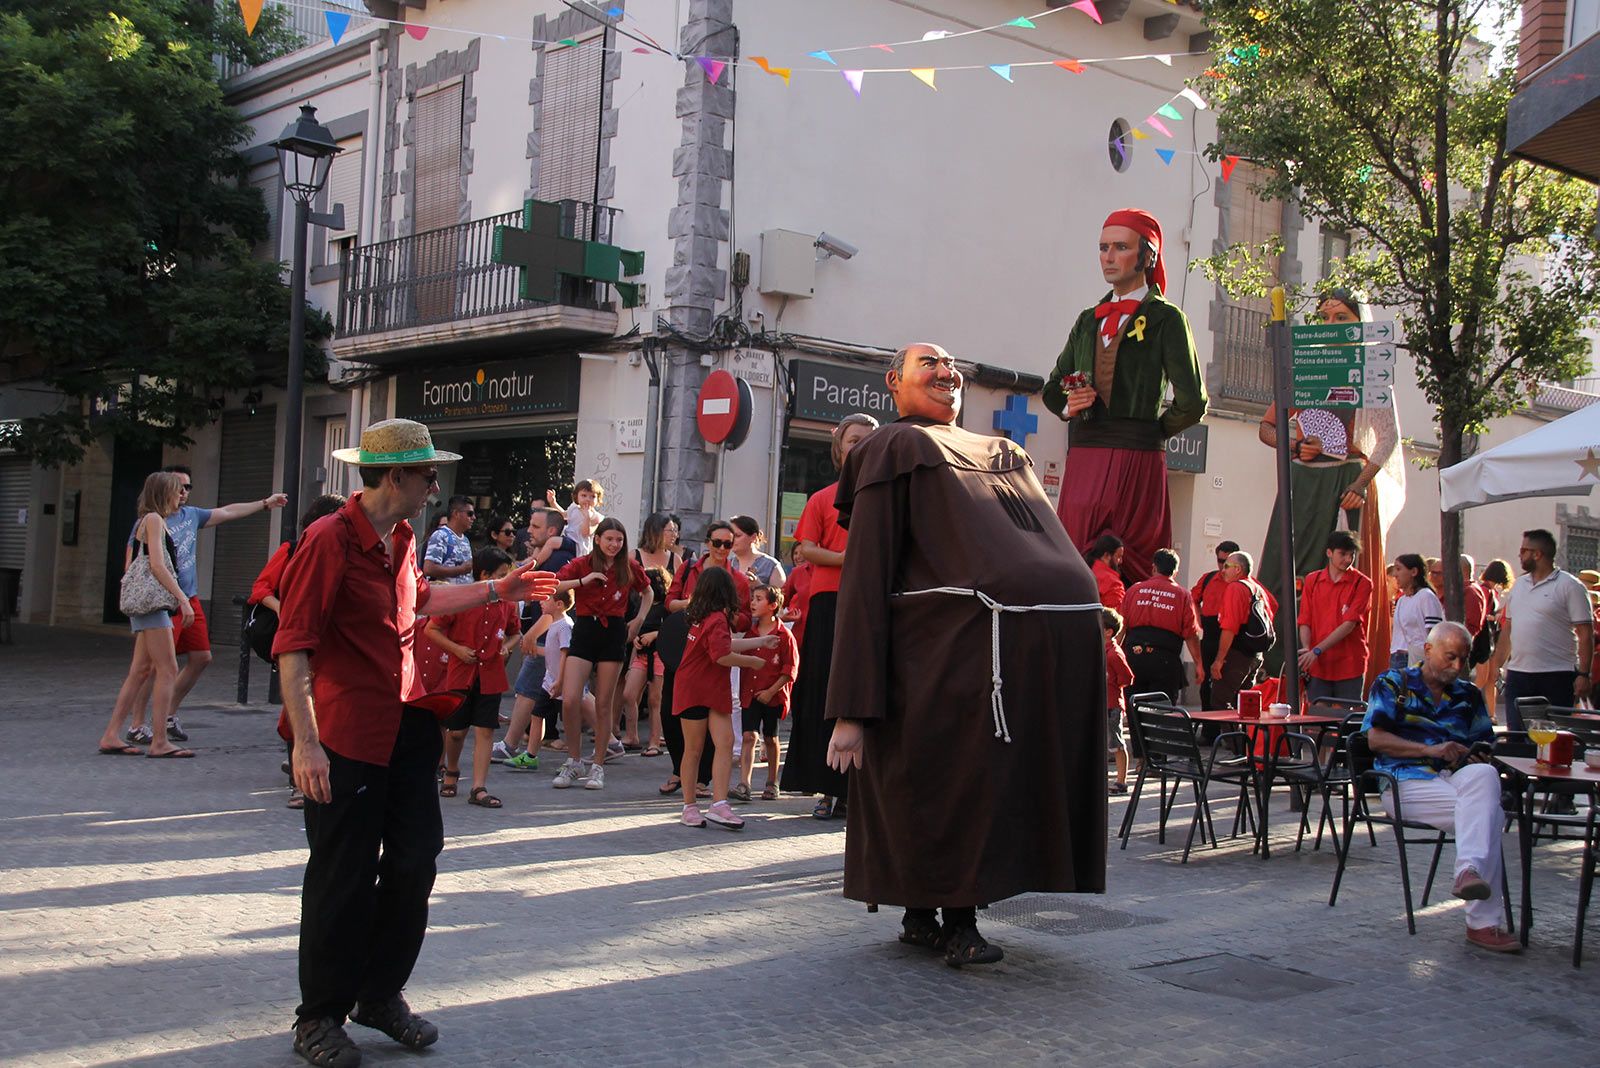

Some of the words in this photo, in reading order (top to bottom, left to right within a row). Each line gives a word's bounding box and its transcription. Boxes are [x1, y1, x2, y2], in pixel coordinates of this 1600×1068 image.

[1294, 332, 1338, 340] Teatre-Auditori
[1294, 357, 1316, 365] Oficina
[423, 380, 472, 406] Farma
[488, 370, 534, 399] natur
[1295, 399, 1315, 407] Quatre
[627, 418, 644, 427] CARRER
[1214, 477, 1223, 487] 65
[1153, 602, 1175, 612] CUGAT
